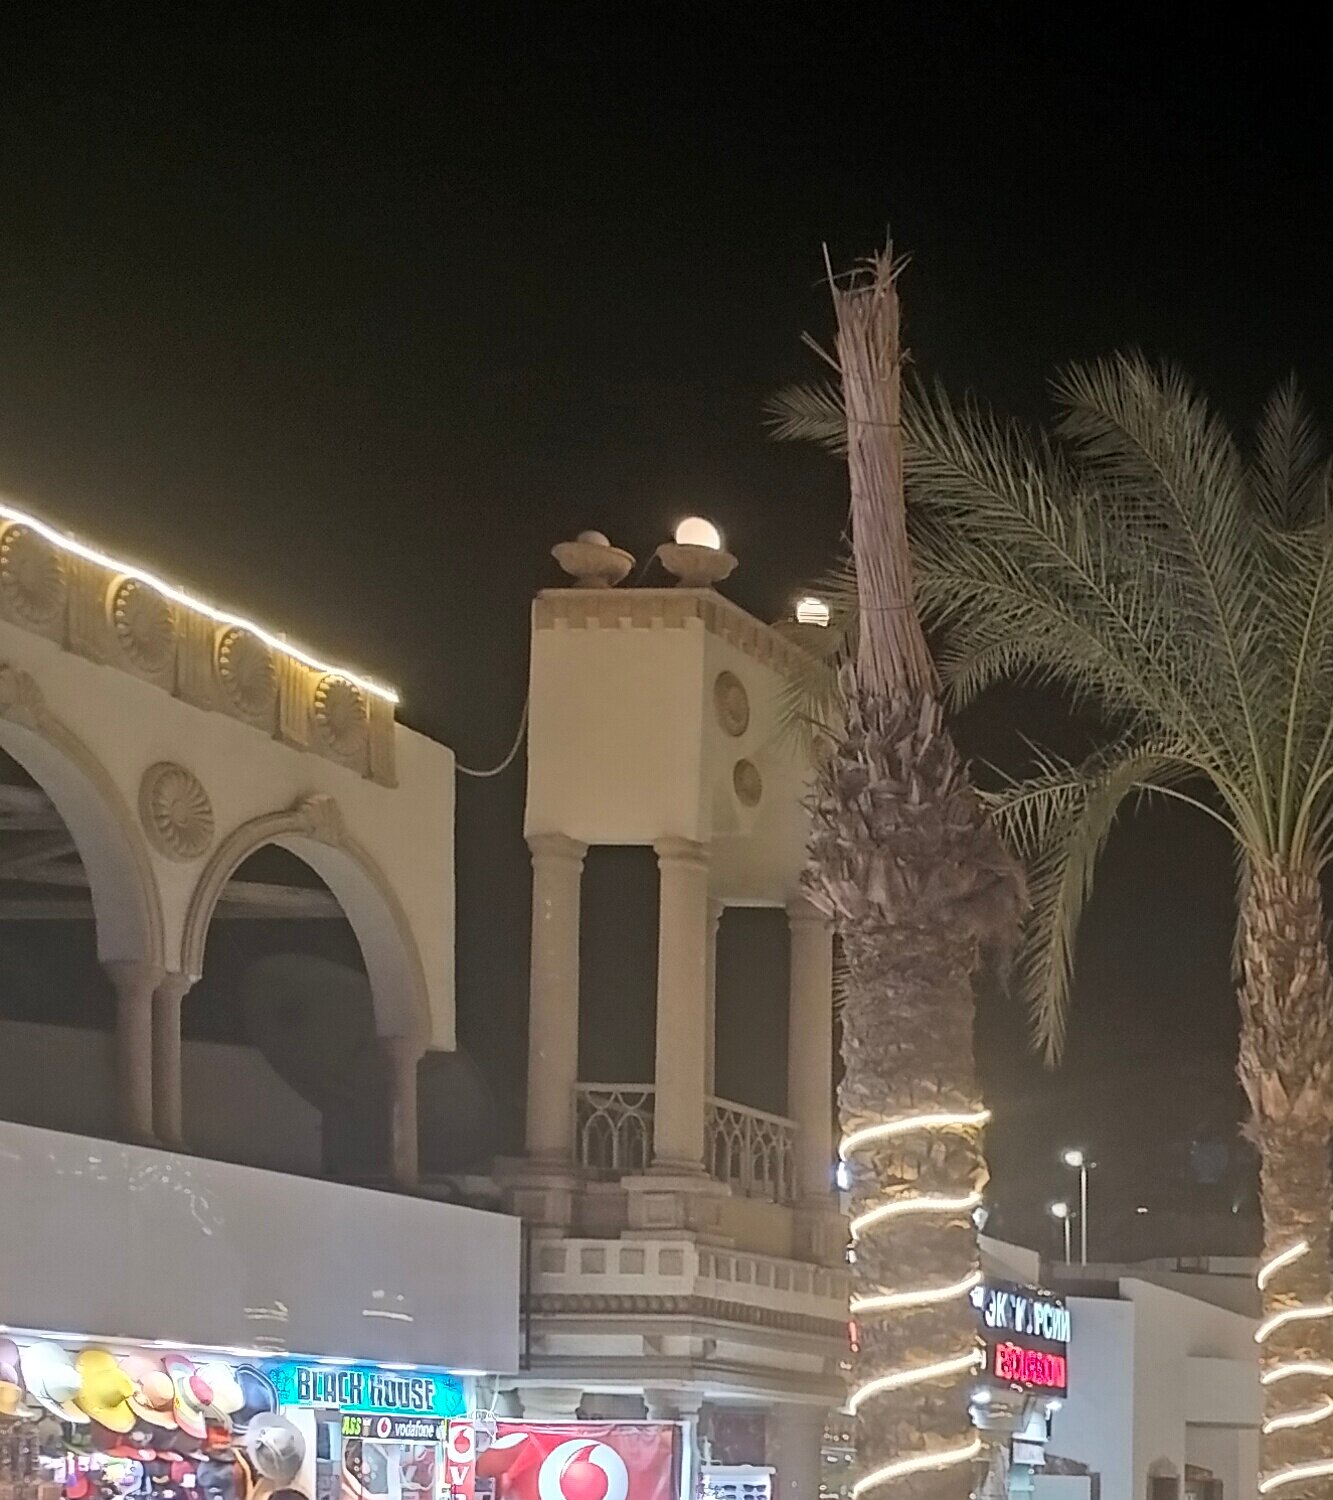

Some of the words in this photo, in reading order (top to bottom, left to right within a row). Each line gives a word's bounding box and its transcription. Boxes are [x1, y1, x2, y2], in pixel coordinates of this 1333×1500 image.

[296, 1367, 362, 1405] BLACK
[369, 1374, 434, 1410] HOUSE
[395, 1420, 434, 1437] vodafone
